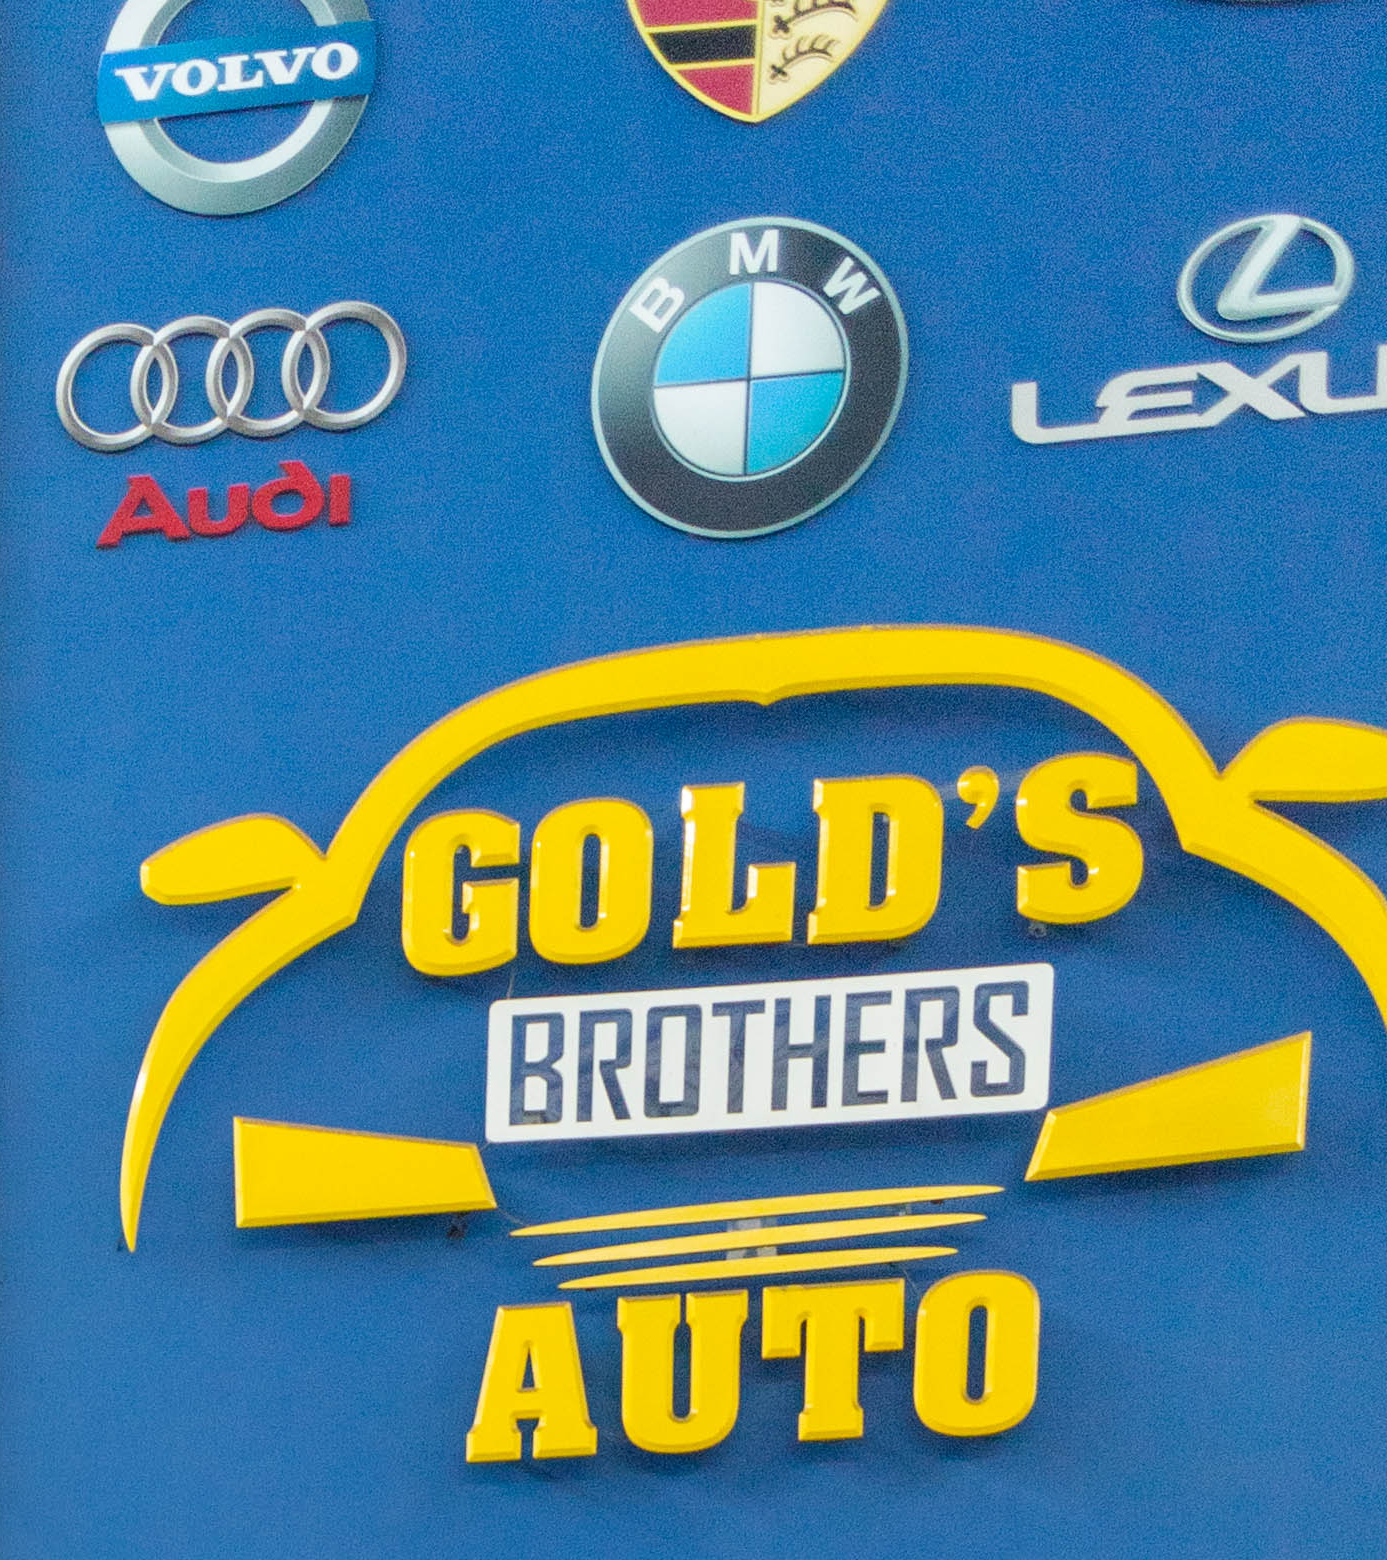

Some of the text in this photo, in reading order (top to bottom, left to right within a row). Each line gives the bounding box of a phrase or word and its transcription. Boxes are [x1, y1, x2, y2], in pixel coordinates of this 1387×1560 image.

[114, 41, 359, 102] VOLVO
[629, 228, 881, 334] BMW
[96, 459, 353, 549] Audi
[401, 751, 1145, 977] GOLD'S
[507, 979, 1029, 1127] BROTHERS
[465, 1269, 1041, 1464] AUTO
